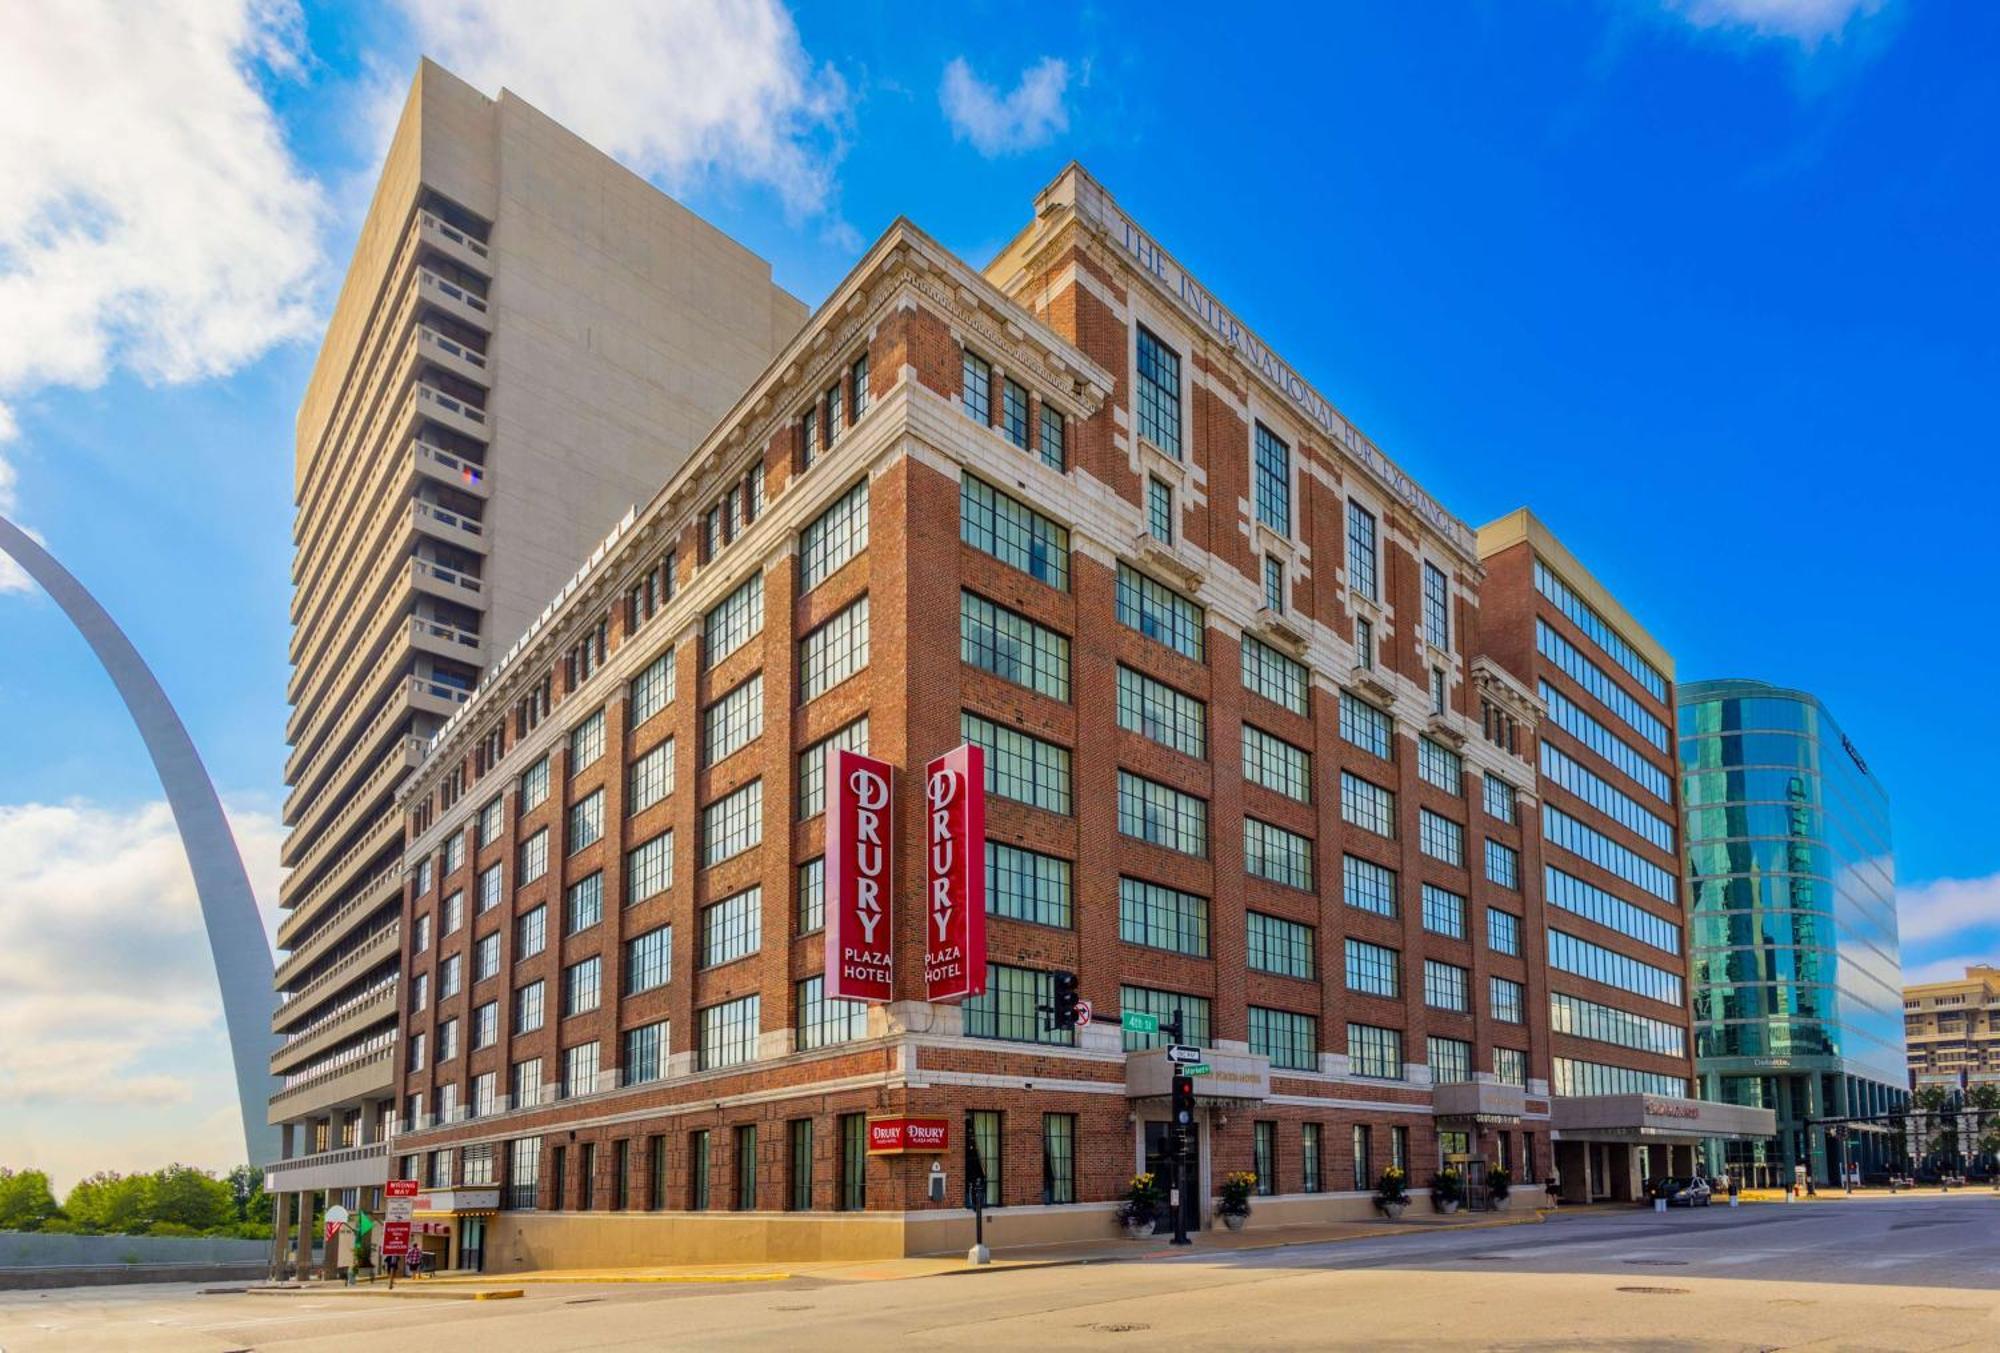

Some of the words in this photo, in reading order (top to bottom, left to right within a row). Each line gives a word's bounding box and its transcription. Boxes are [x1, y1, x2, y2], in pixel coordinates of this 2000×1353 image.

[1120, 219, 1168, 284] THE
[1180, 271, 1338, 438] INTERNATIONAL
[1344, 421, 1375, 467] FUR
[1382, 457, 1455, 537] EXCHANGE
[849, 768, 889, 944] DRURY
[927, 768, 957, 942] DRURY
[844, 947, 892, 965] PLAZA
[925, 945, 961, 965] PLAZA
[844, 964, 892, 983] HOTEL
[925, 963, 961, 983] HOTEL
[873, 1127, 901, 1139] DRURY
[906, 1124, 945, 1139] DRURY
